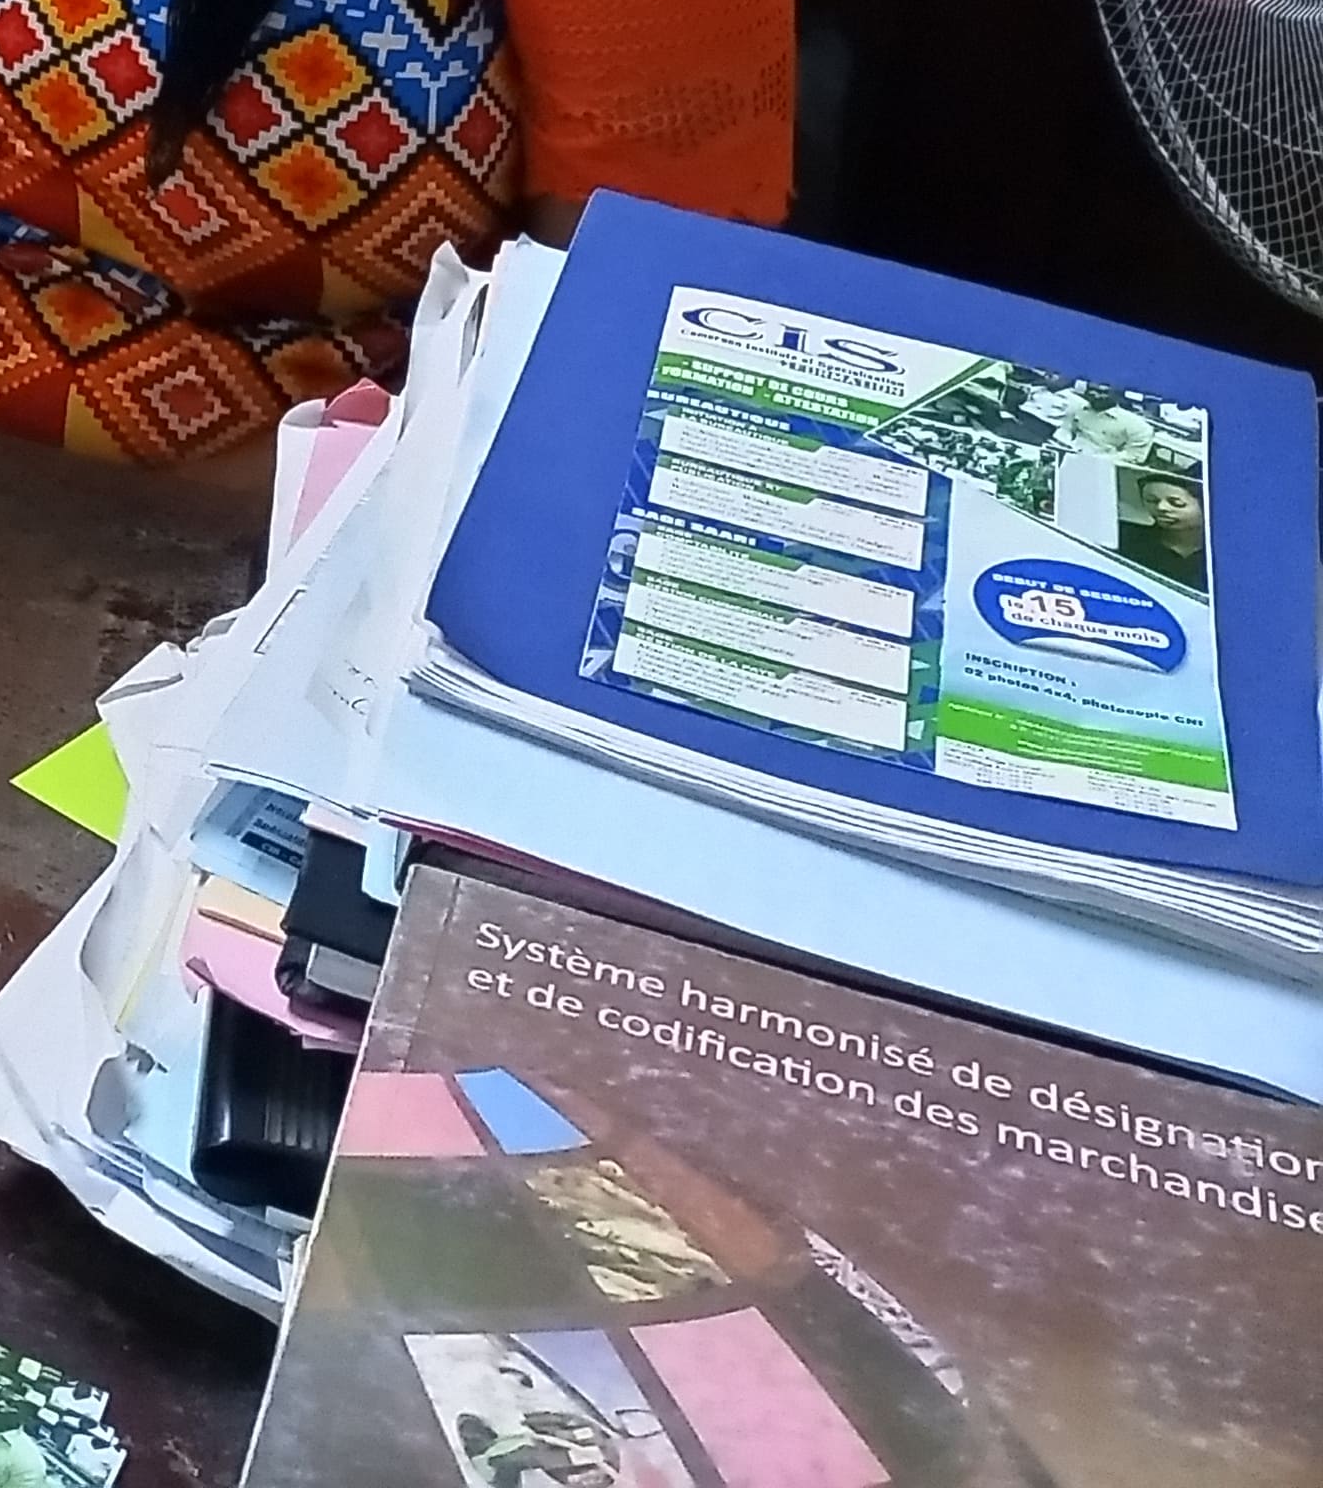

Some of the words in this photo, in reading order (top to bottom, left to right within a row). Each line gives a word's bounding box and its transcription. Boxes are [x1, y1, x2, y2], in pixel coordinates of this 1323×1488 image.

[681, 307, 906, 376] CIS
[659, 364, 755, 396] FORMATION
[772, 392, 879, 427] ATTESTATION
[690, 359, 766, 387] SUPPORT
[791, 385, 849, 408] COURS
[1029, 594, 1077, 617] 15
[1078, 587, 1154, 608] SESSION
[1039, 615, 1108, 635] chaque
[1113, 628, 1161, 645] mois
[964, 652, 1067, 687] INSCRIPTION
[964, 666, 983, 678] 02
[987, 672, 1040, 694] photos
[1081, 696, 1171, 722] photocopie
[474, 921, 667, 1000] Système
[681, 978, 935, 1077] harmonisé
[951, 1060, 1013, 1100] de
[467, 967, 515, 999] et
[525, 983, 585, 1018] de
[596, 1004, 876, 1106] codification
[892, 1089, 980, 1137] des
